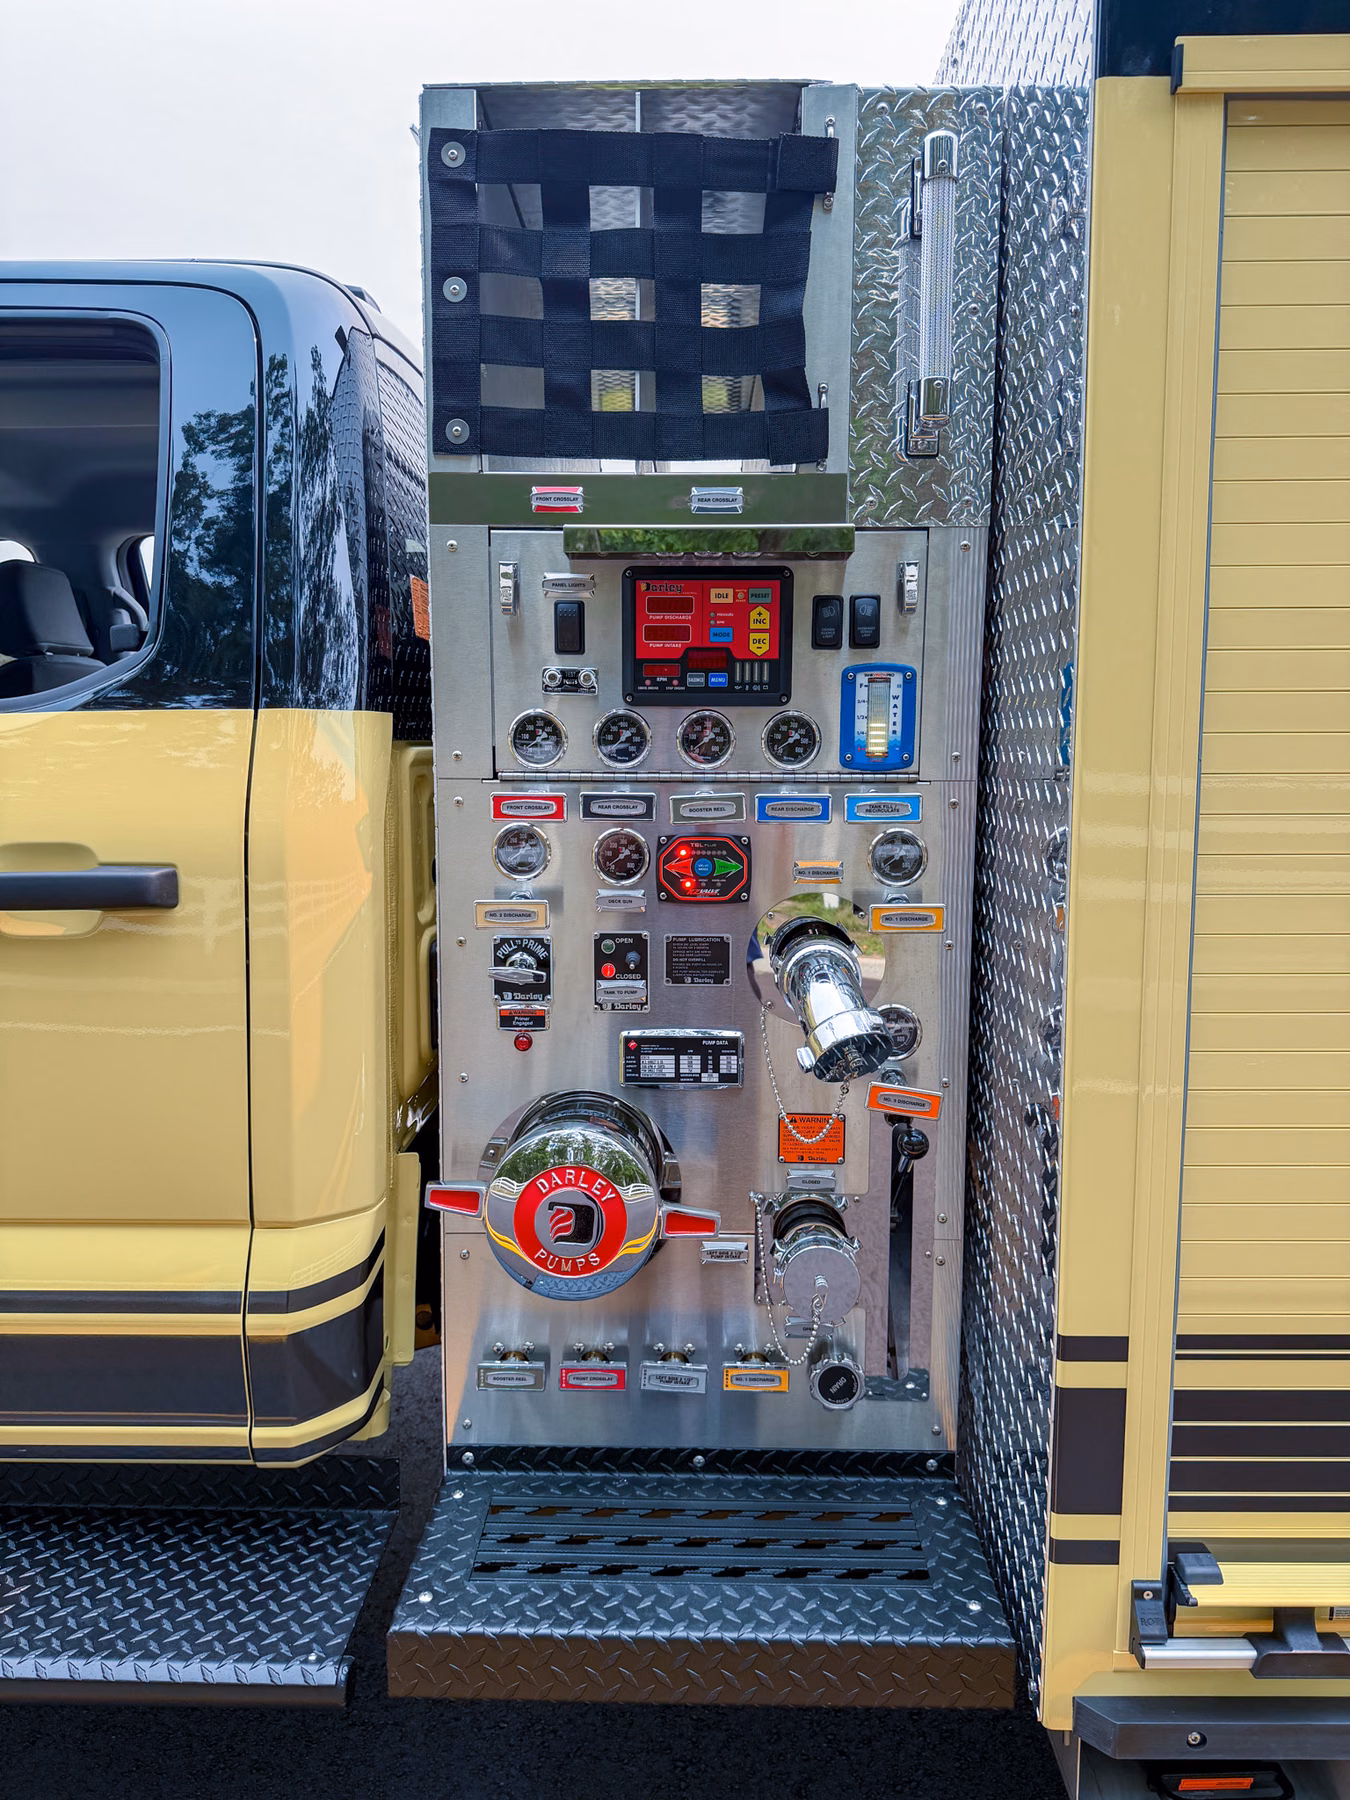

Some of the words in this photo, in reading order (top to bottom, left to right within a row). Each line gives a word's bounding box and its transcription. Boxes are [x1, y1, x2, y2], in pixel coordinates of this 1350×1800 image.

[496, 940, 518, 959] PULL
[522, 938, 549, 960] PRIME
[513, 992, 543, 1001] Darley
[897, 1099, 926, 1108] DISCHARGE
[536, 1169, 616, 1202] DARLEY
[534, 1248, 601, 1272] PUMPS
[829, 1376, 847, 1394] DRAIN
